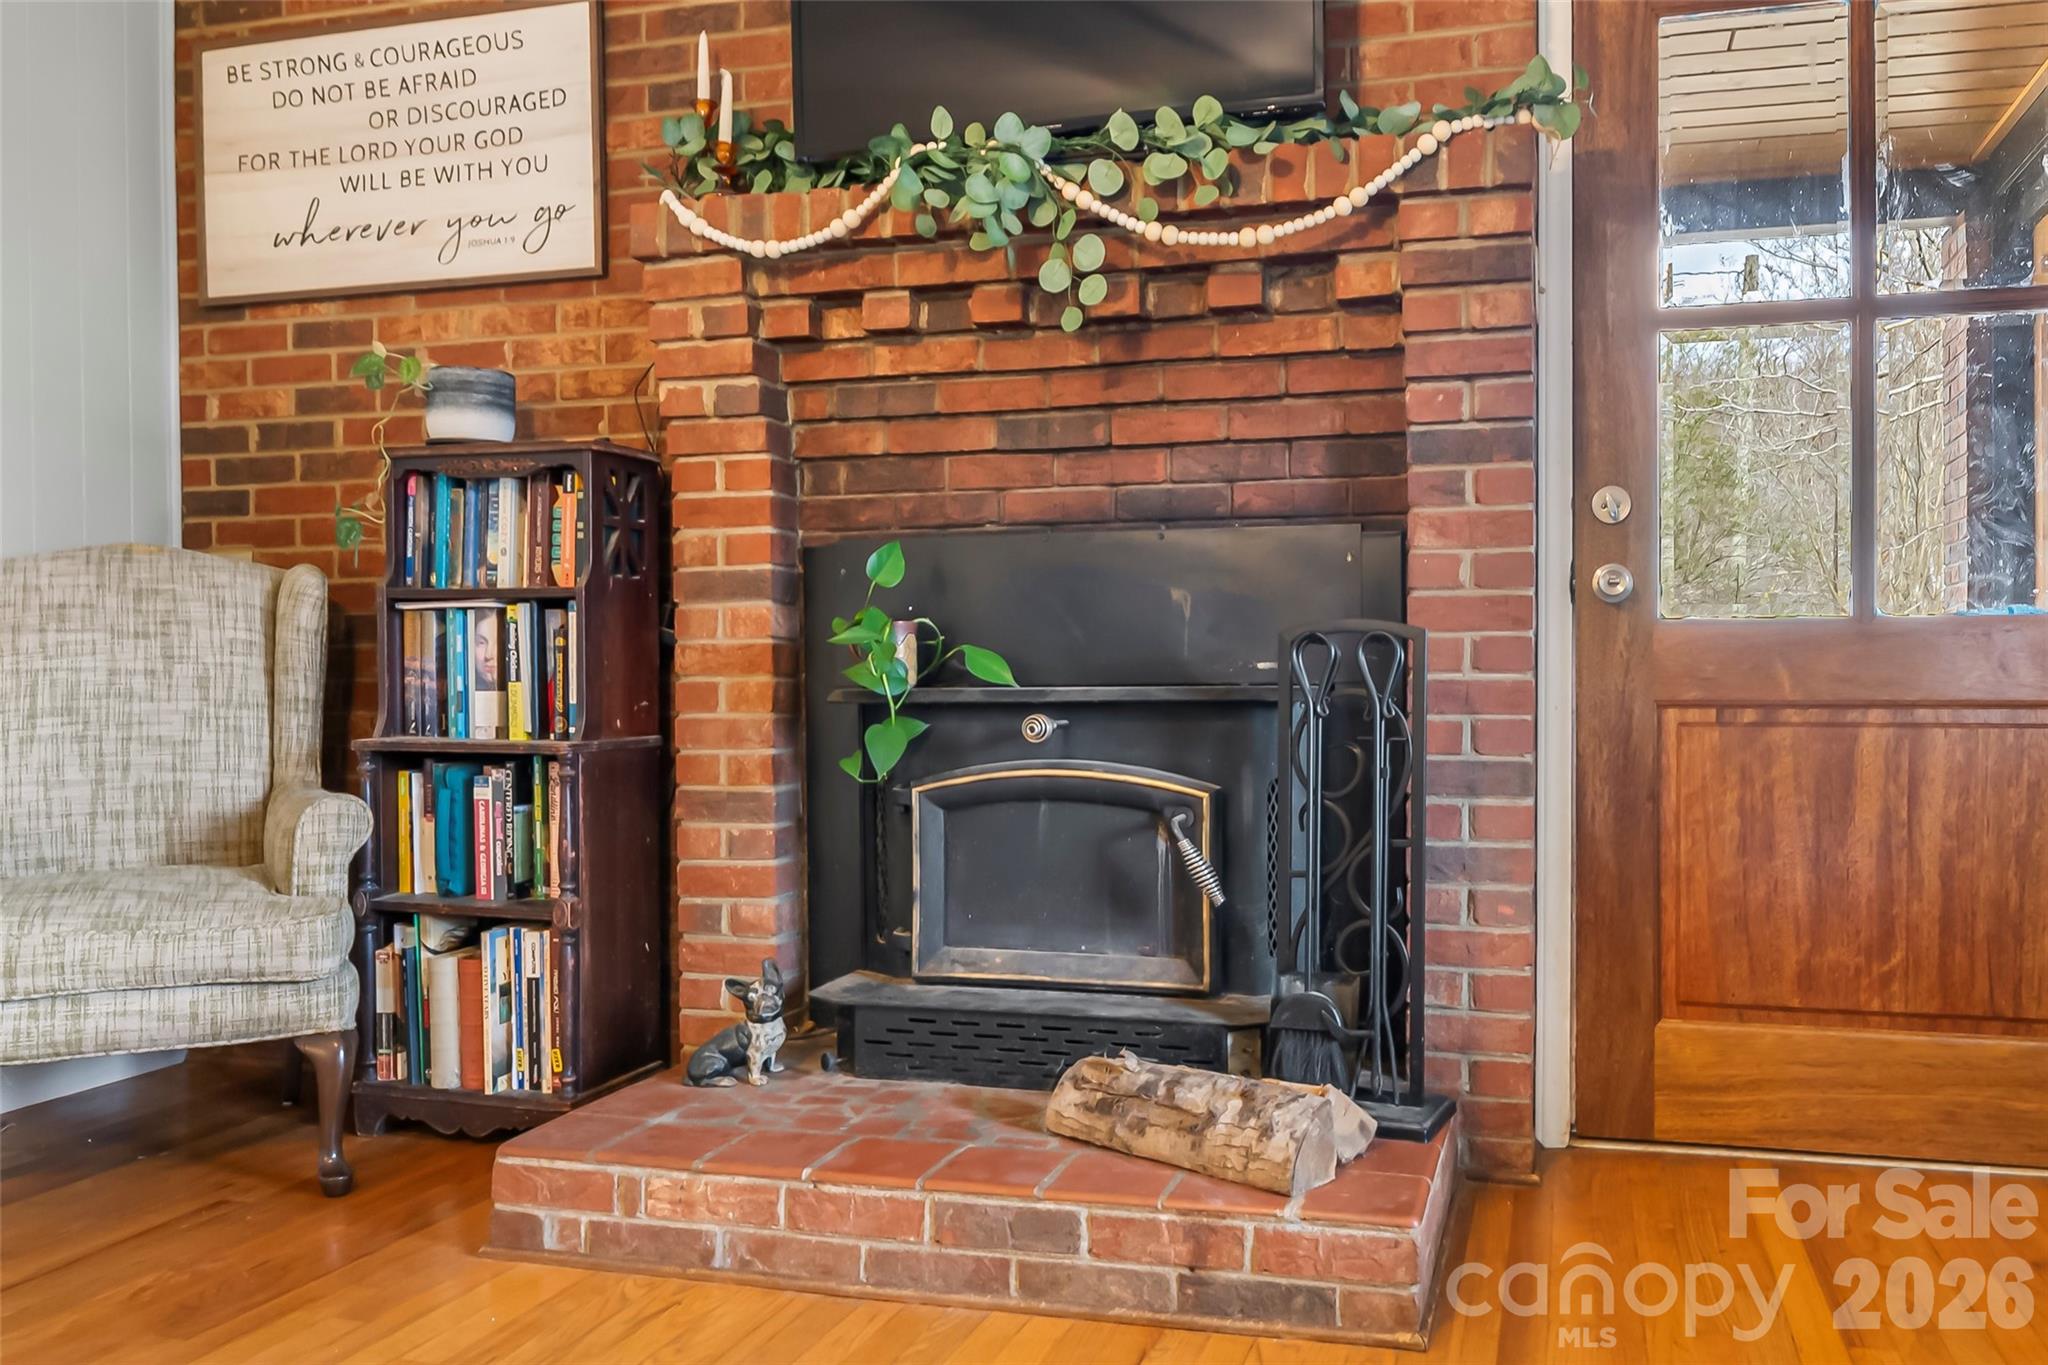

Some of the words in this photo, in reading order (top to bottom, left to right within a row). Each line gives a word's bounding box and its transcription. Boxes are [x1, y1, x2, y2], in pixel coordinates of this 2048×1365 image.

[226, 65, 252, 84] BE
[259, 52, 347, 81] STRONG
[354, 53, 365, 69] &
[369, 30, 524, 68] COURAGEOUS
[272, 89, 304, 109] DO
[312, 83, 355, 106] NOT
[364, 79, 391, 99] BE
[398, 68, 477, 96] AFRAID
[368, 109, 399, 130] OR
[407, 88, 567, 126] DISCOURAGED
[238, 152, 281, 173] FOR
[288, 147, 331, 169] THE
[339, 141, 398, 164] LORD
[404, 132, 466, 157] YOUR
[474, 126, 523, 150] GOD
[339, 173, 392, 194] WILL
[400, 169, 426, 188] BE
[433, 161, 493, 185] WITH
[500, 154, 548, 177] YOU
[273, 197, 428, 248] wherever
[437, 213, 518, 265] you
[522, 203, 577, 255] go
[467, 237, 502, 249] JOSHUA
[504, 769, 513, 822] CENTERED
[505, 823, 513, 859] RIDING
